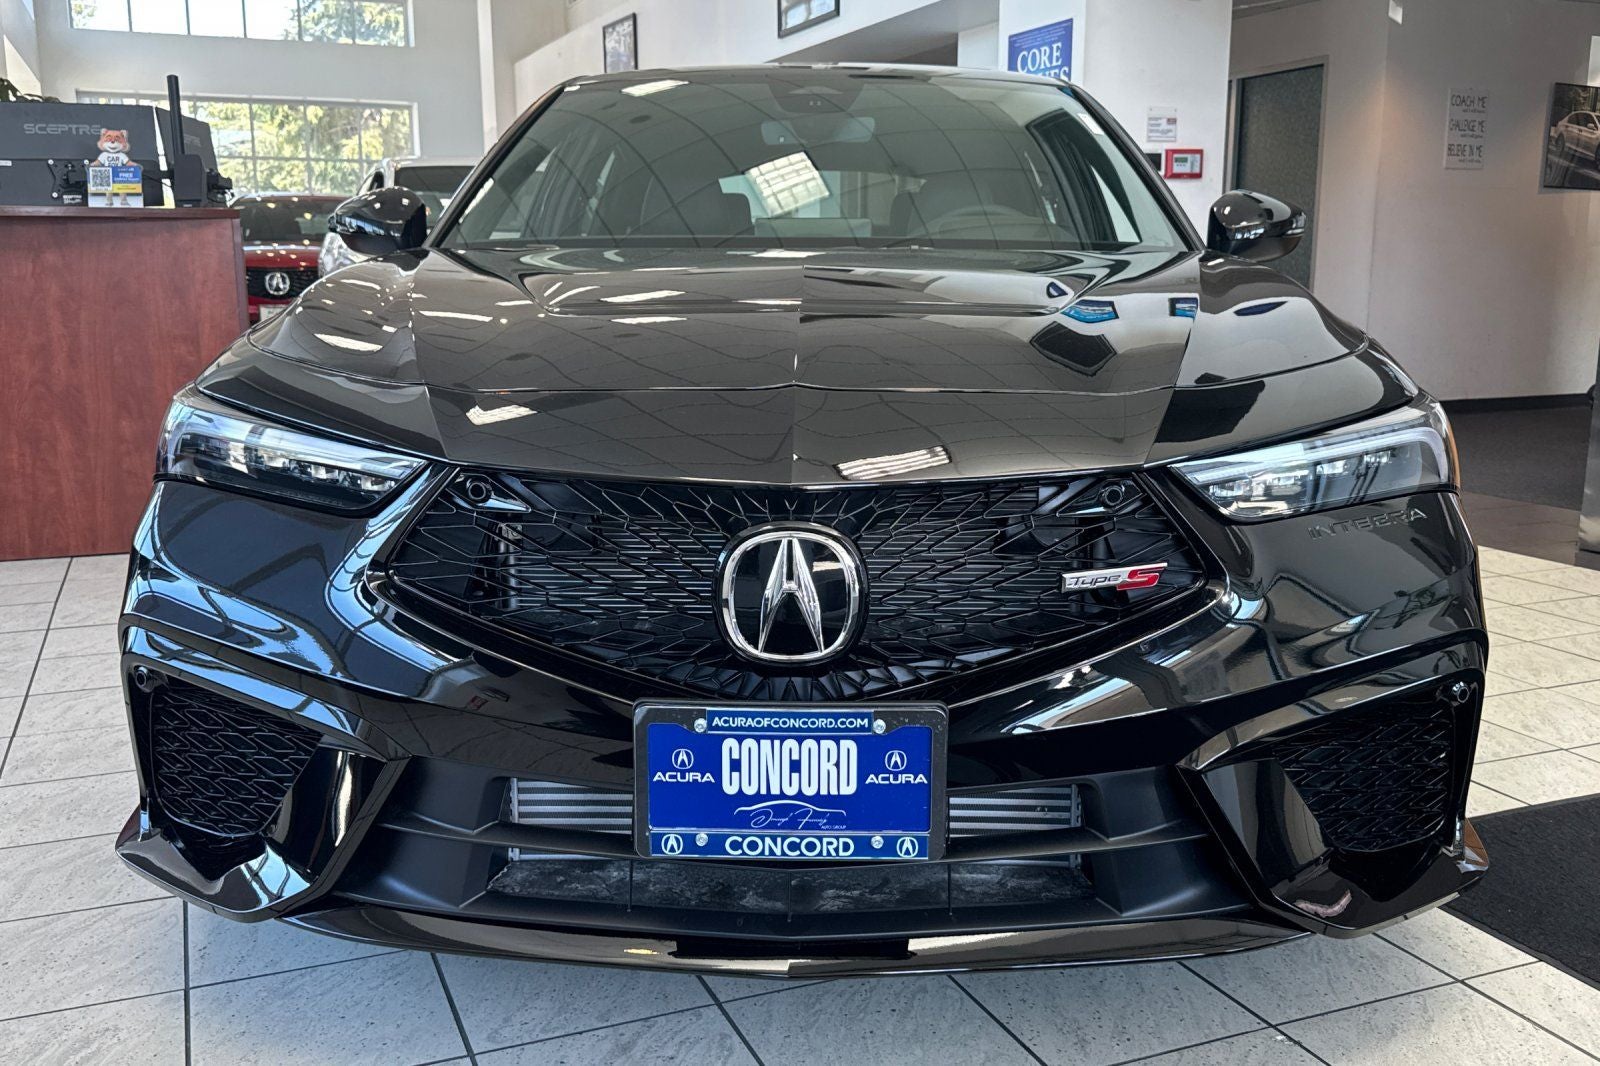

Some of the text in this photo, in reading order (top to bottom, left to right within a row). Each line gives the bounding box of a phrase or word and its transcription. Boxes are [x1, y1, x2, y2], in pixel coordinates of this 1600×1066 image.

[1017, 42, 1062, 73] CORE
[1450, 94, 1488, 108] COACH ME
[23, 123, 102, 136] SCEPTRE
[1067, 563, 1167, 591] Type S
[712, 716, 869, 729] ACURAOFCONCORD.COM
[721, 737, 858, 797] CONCORD
[652, 771, 716, 784] ACURA
[864, 773, 928, 785] ACURA
[724, 835, 855, 857] CONCORD
